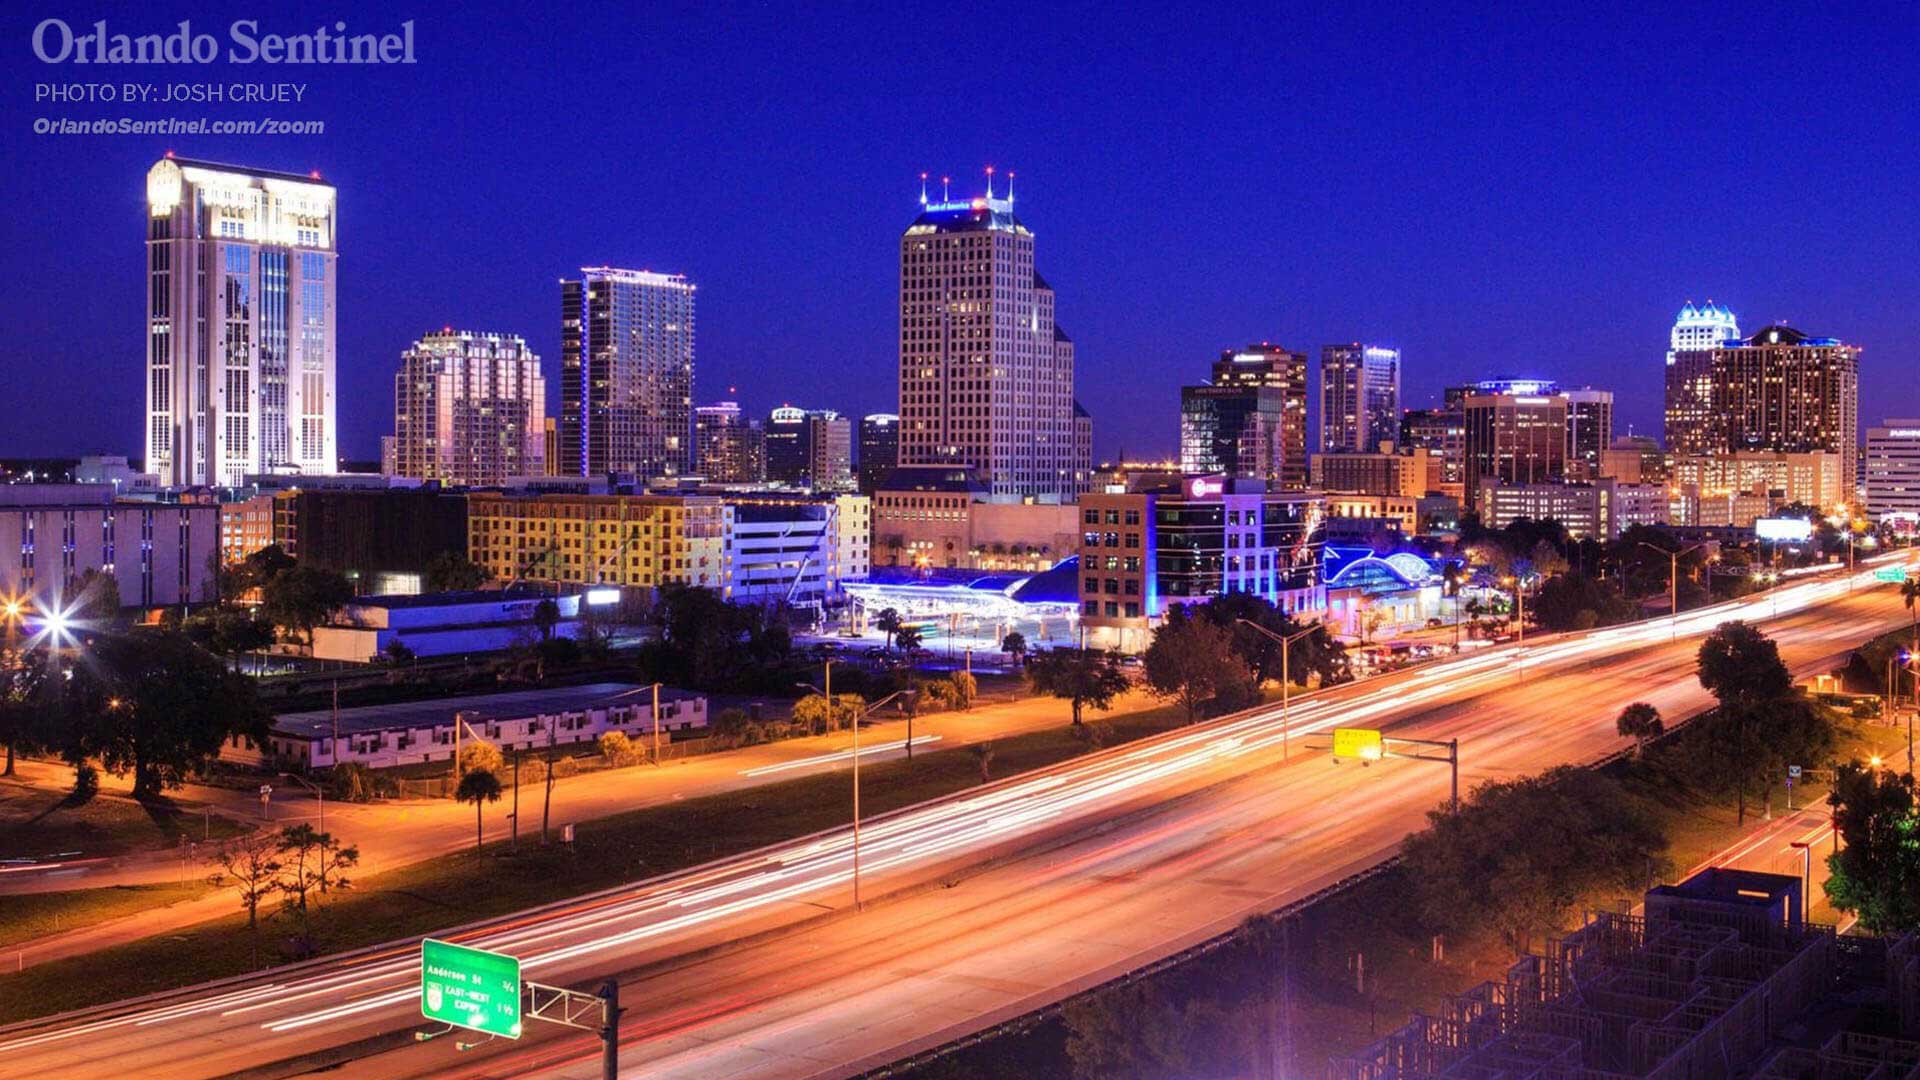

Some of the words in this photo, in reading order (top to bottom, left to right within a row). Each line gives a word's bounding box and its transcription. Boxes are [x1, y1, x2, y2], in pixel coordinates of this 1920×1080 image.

[427, 964, 466, 982] Anderson
[472, 973, 482, 985] St
[445, 985, 490, 1004] EAST-WEST
